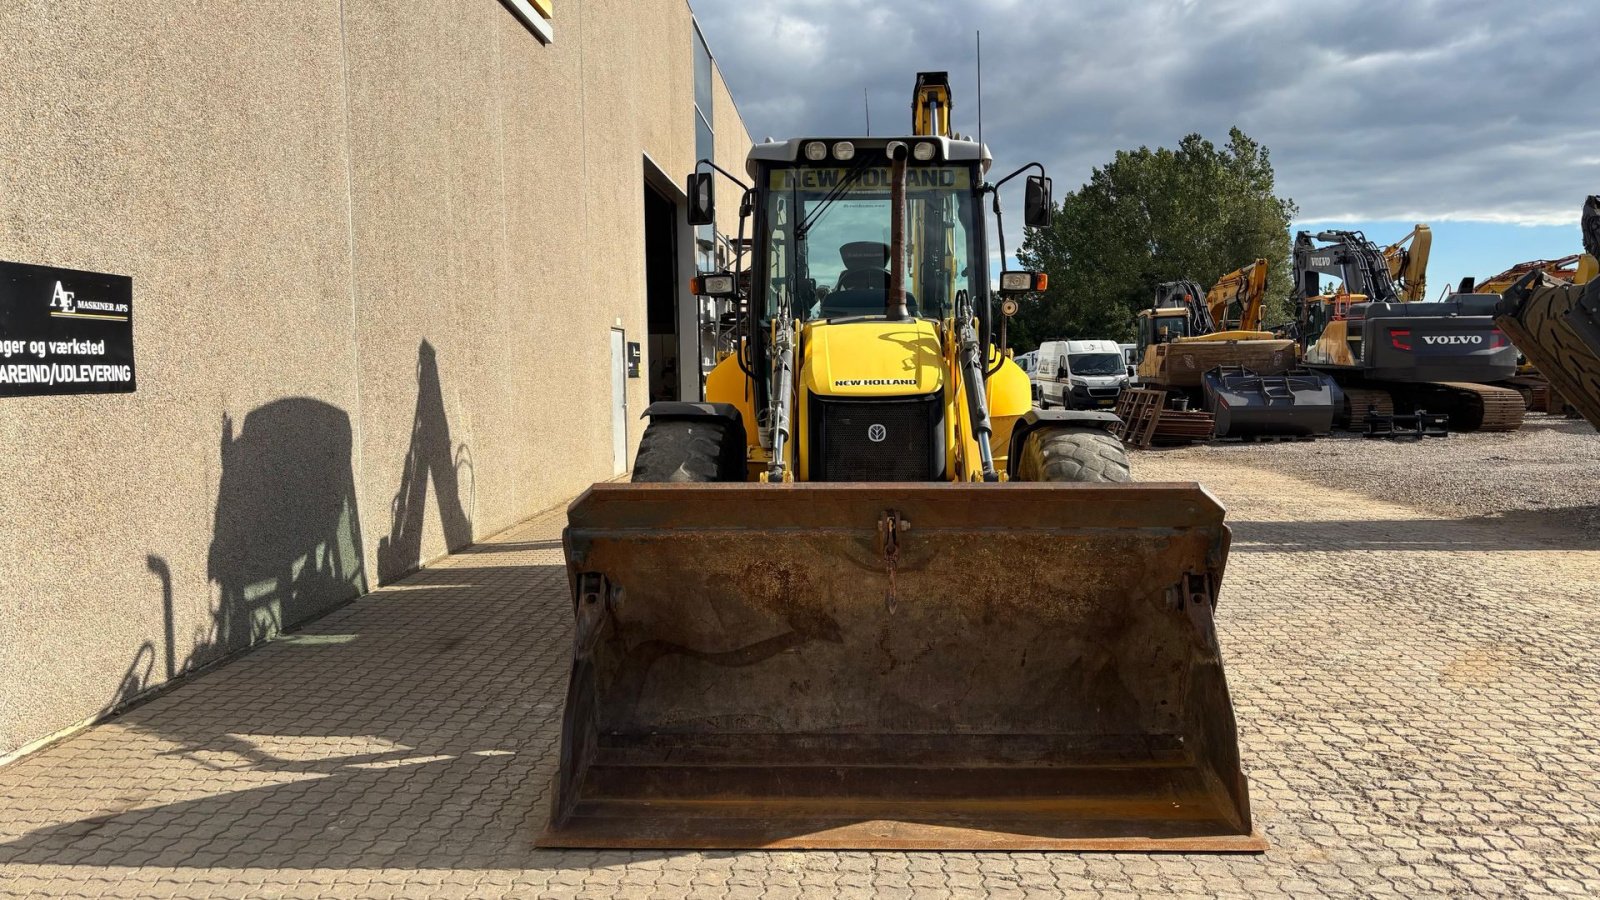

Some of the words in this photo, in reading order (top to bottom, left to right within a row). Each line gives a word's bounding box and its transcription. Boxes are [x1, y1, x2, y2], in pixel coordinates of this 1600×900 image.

[785, 170, 838, 187] NEW
[846, 170, 955, 187] HOLAND
[1311, 257, 1330, 266] VOLVO
[77, 300, 114, 311] MASKINER
[115, 304, 128, 312] APS
[1422, 336, 1482, 344] VOLVO
[30, 341, 46, 358] og
[49, 338, 105, 355] værksted
